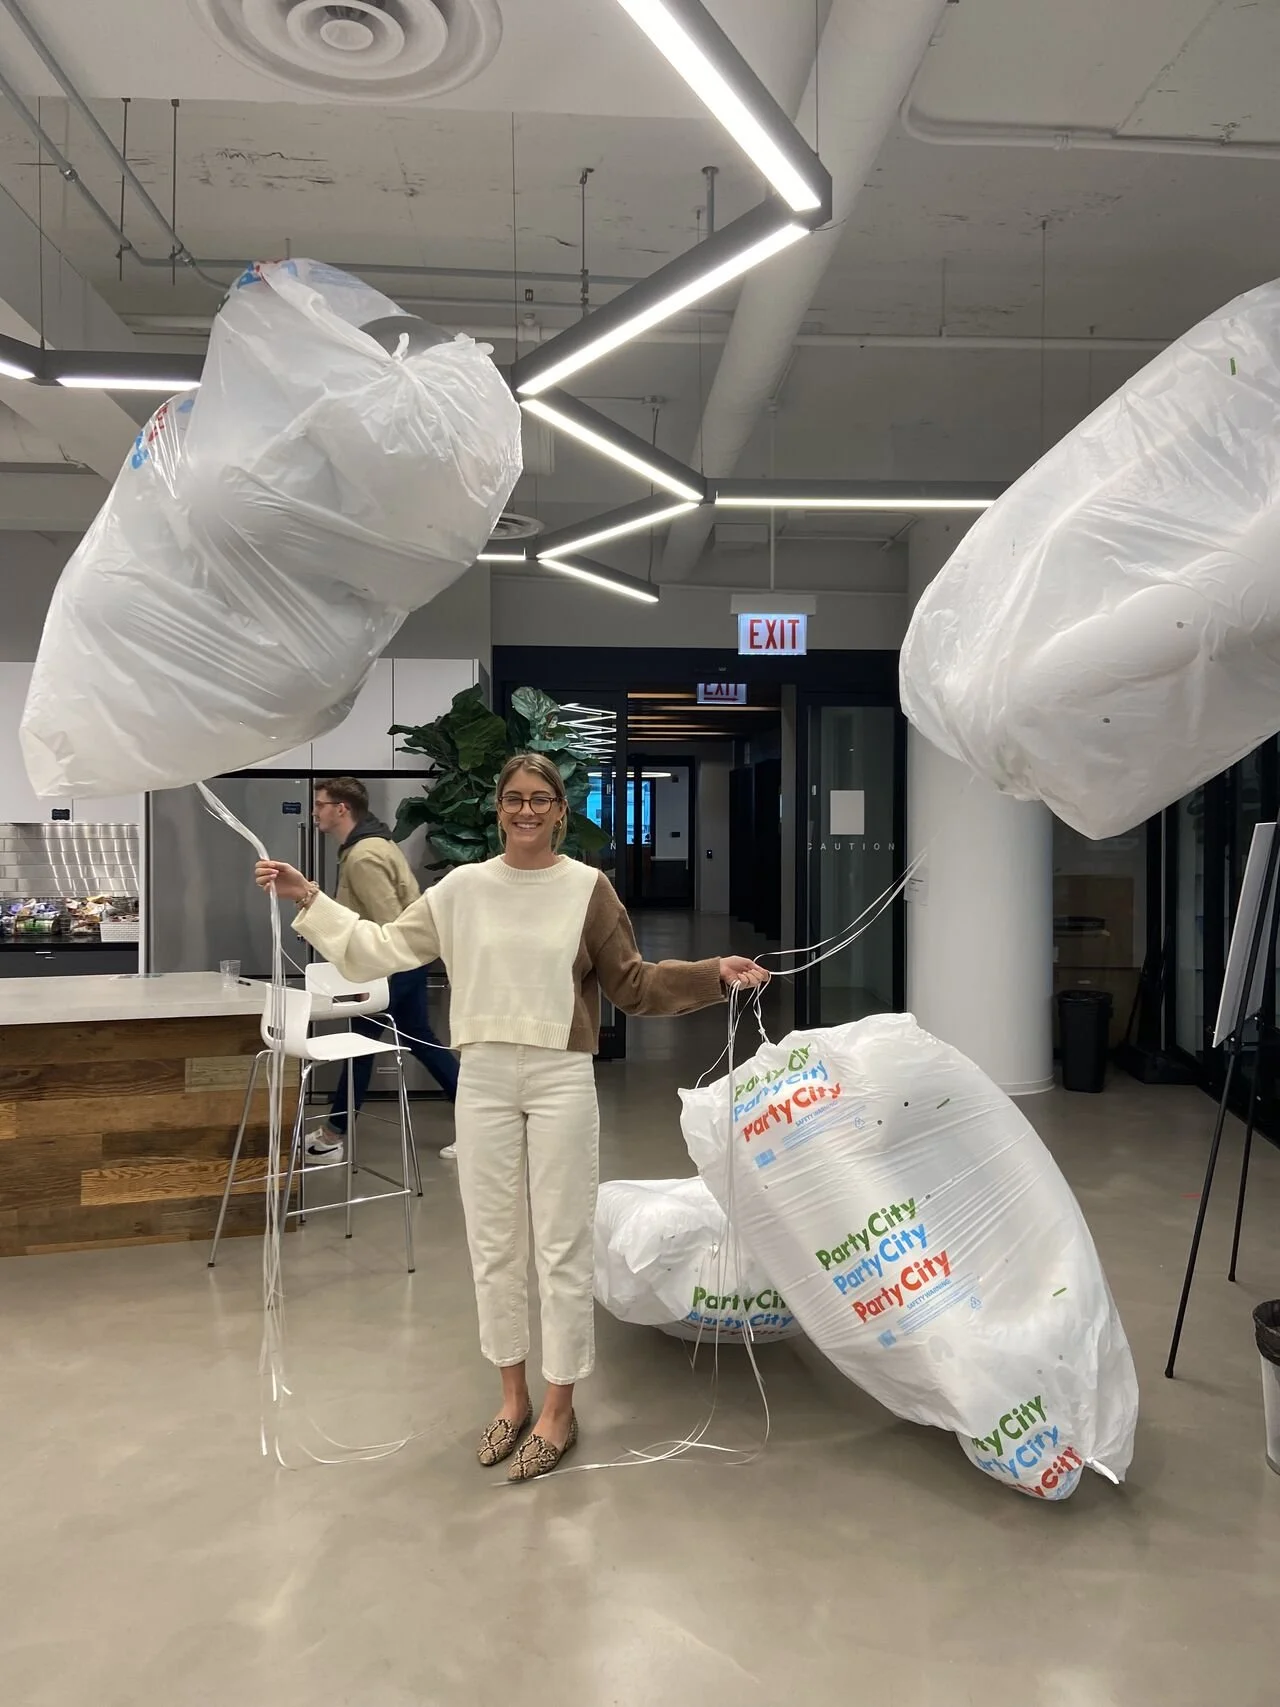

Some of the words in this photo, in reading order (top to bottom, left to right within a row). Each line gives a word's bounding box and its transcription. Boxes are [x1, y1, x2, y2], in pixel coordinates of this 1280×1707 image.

[749, 619, 800, 650] EXIT
[807, 842, 896, 851] CAUTION
[906, 1295, 925, 1310] SAFETY
